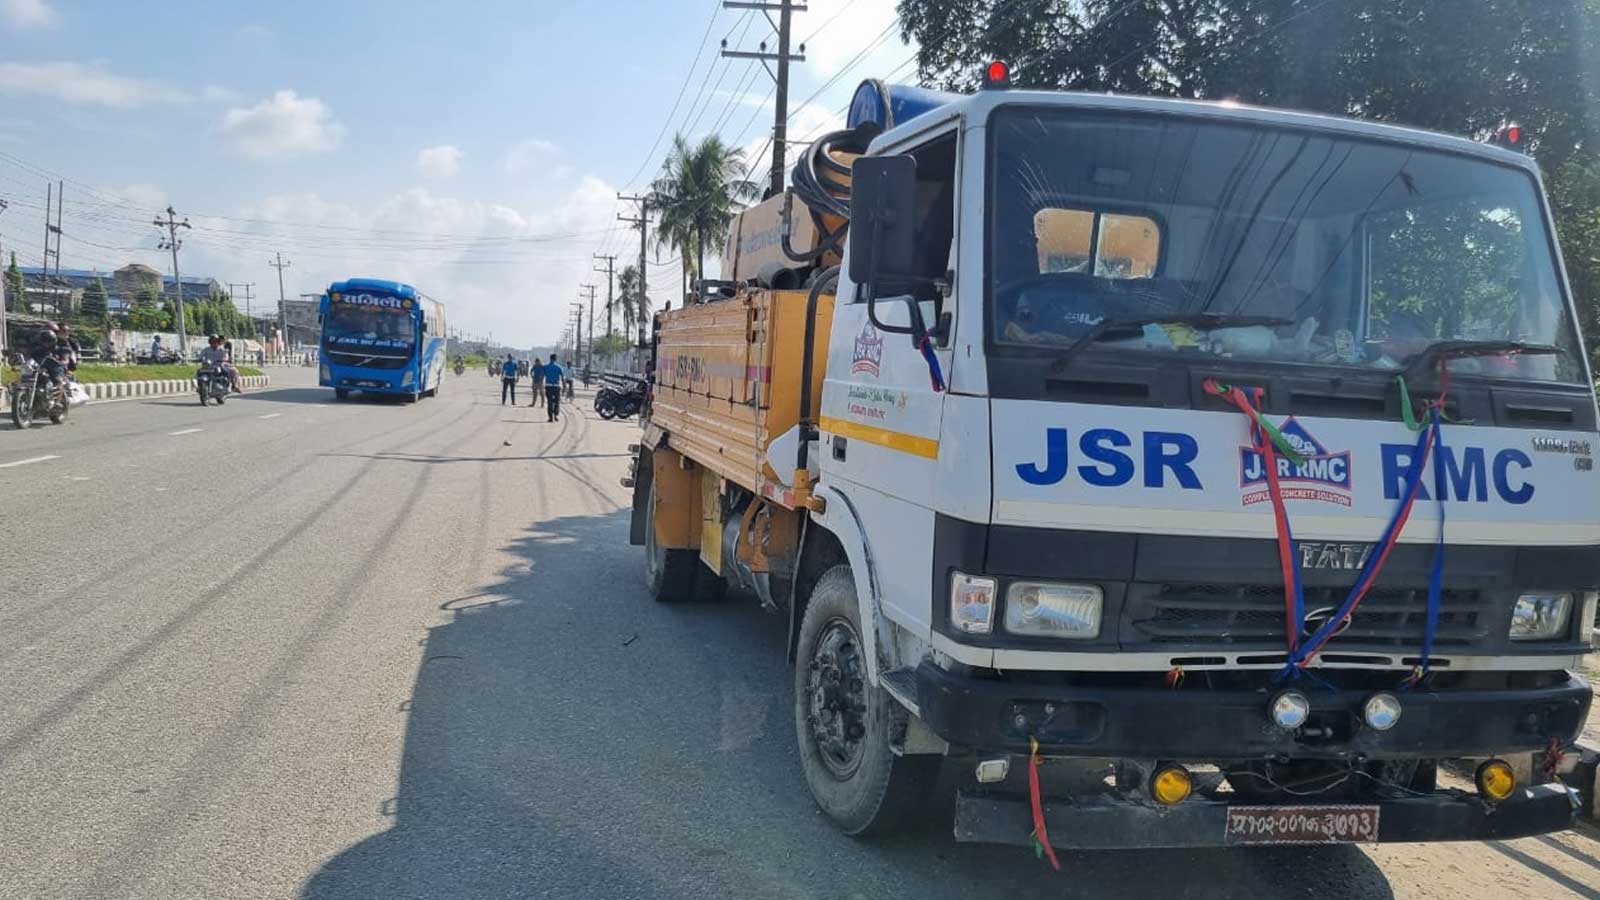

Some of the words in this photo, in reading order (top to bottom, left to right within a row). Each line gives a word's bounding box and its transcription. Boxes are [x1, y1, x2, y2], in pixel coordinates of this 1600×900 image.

[1016, 427, 1204, 490] JSR
[1380, 442, 1535, 505] RMC
[1245, 453, 1291, 480] JR
[1296, 458, 1347, 482] RMC
[1243, 490, 1273, 504] COMPLE
[1280, 488, 1316, 500] CONCRETE
[1317, 490, 1350, 506] SOLUTION
